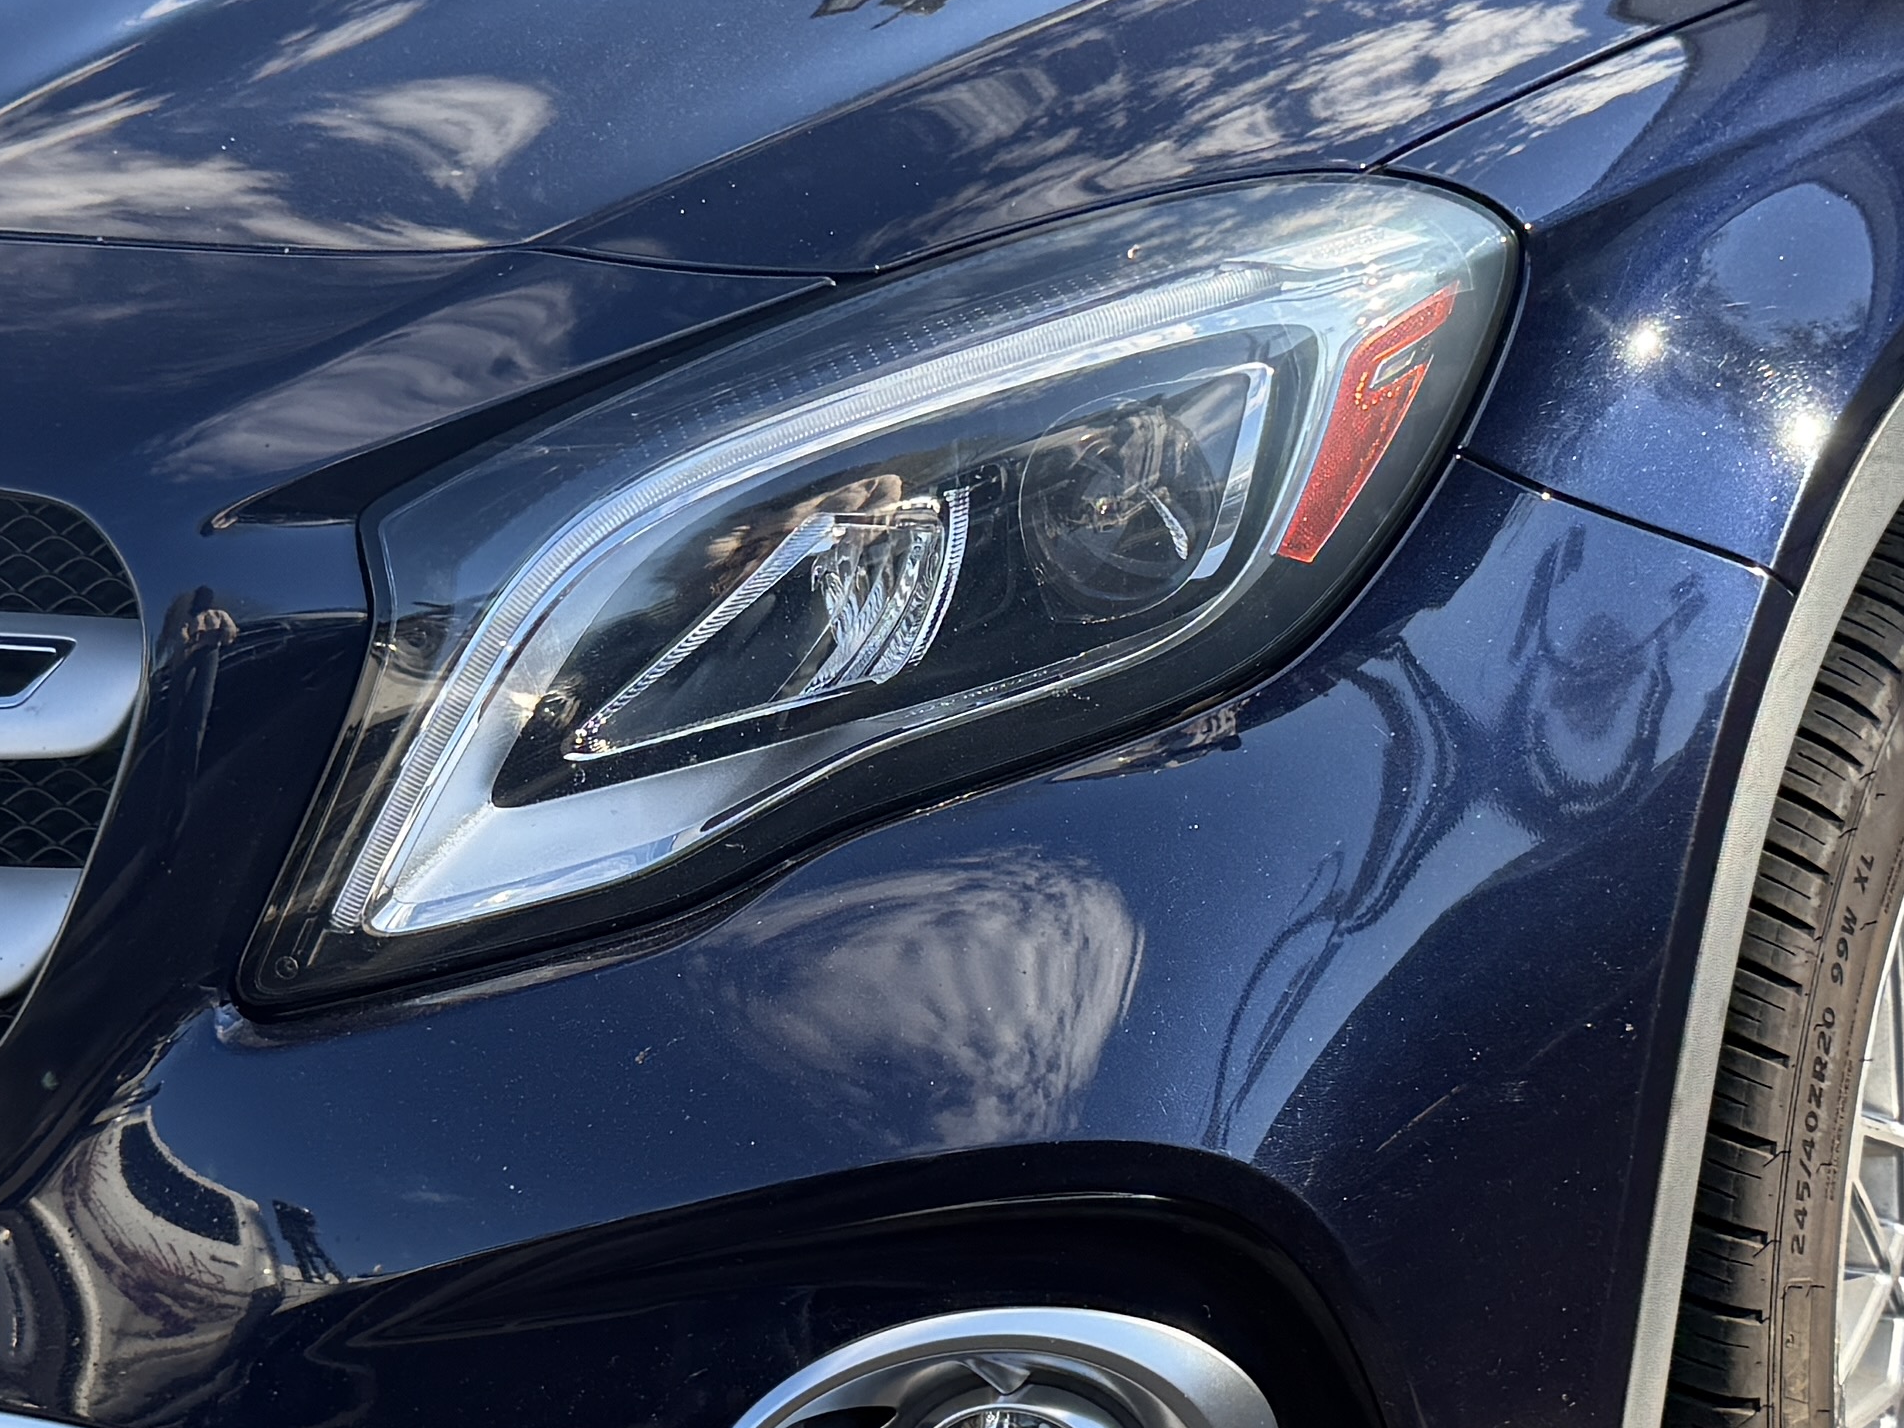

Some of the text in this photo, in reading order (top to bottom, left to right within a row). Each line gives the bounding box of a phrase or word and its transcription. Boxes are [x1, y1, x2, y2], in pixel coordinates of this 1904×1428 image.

[1791, 853, 1875, 1256] 245/40ZR20 99W XL
